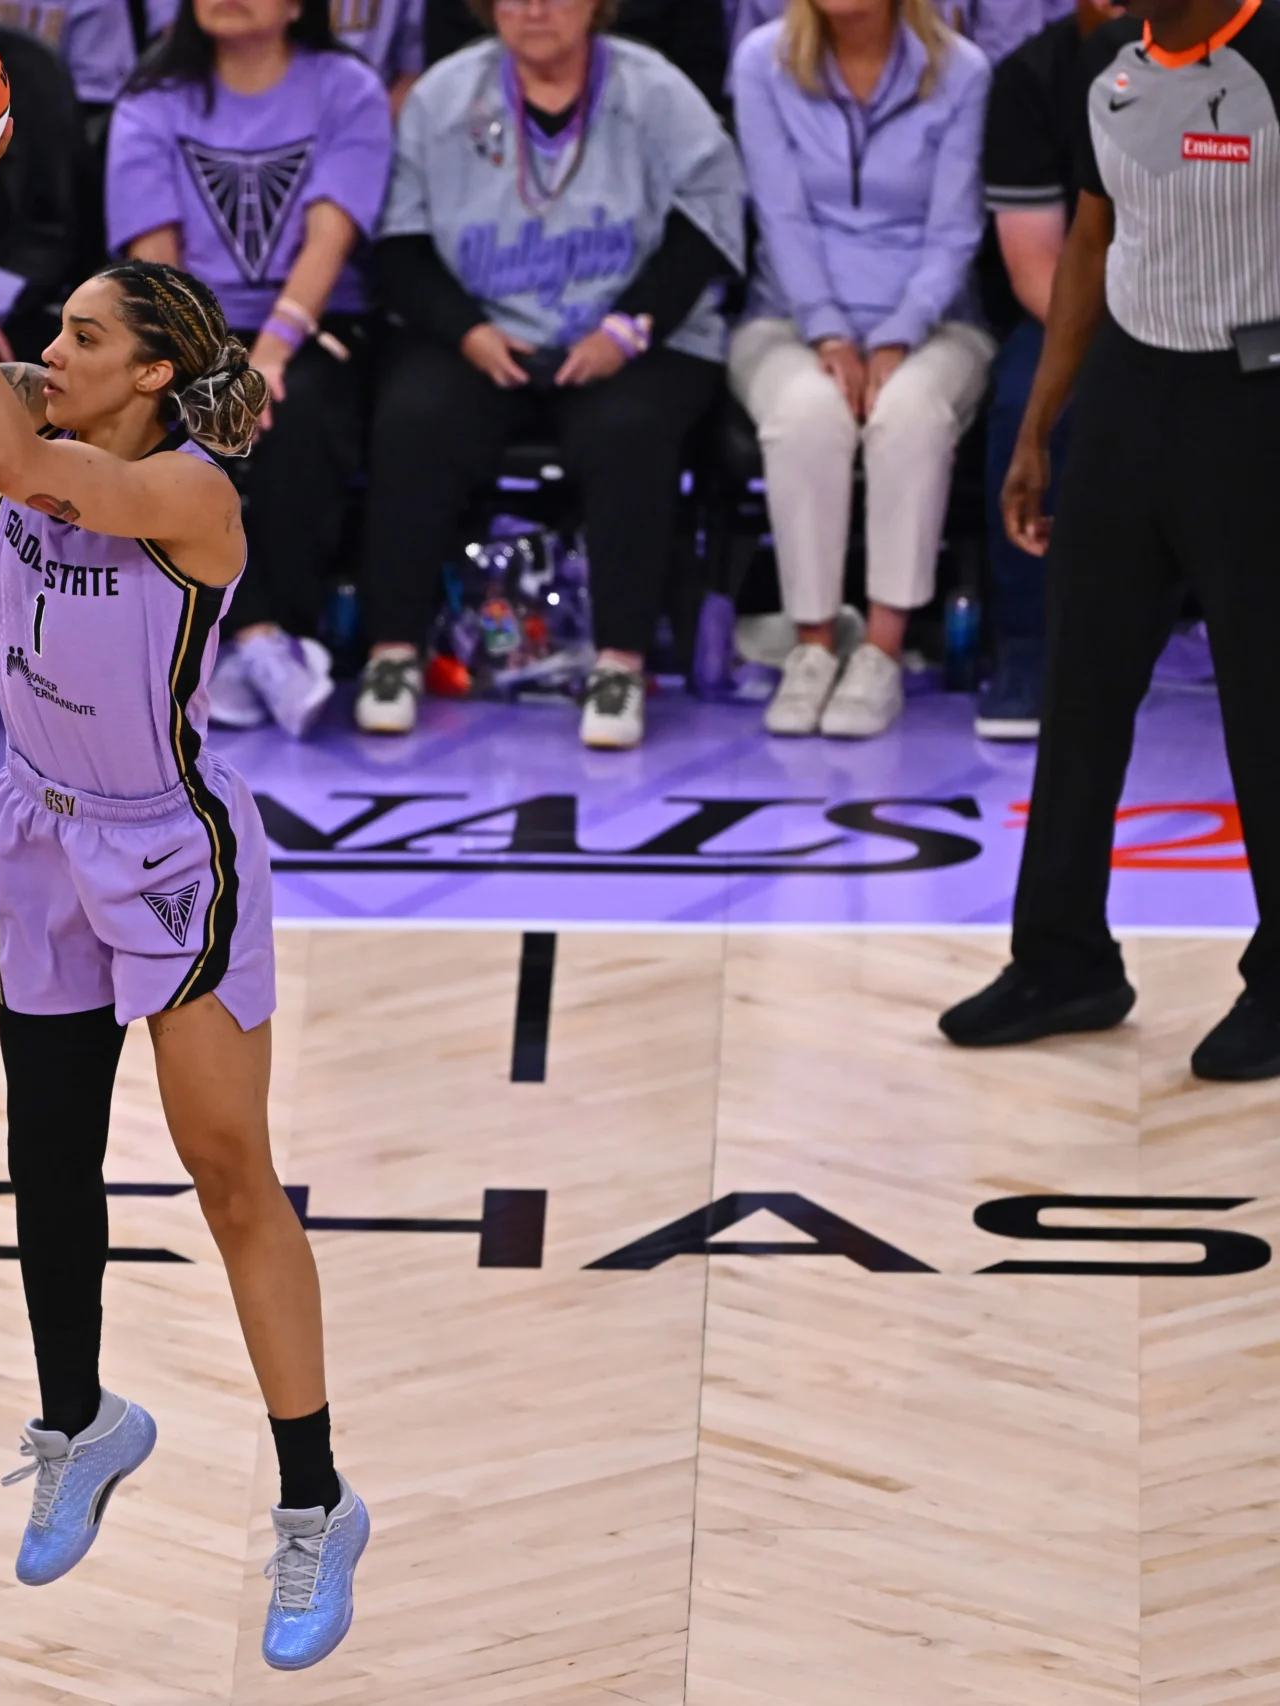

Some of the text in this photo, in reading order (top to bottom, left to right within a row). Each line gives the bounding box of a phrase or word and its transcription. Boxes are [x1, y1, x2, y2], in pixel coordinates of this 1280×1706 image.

[1183, 137, 1249, 158] Emirates
[44, 559, 119, 597] STATE
[33, 590, 46, 658] 1
[33, 685, 97, 717] ERMANENTE
[45, 787, 75, 817] GSV
